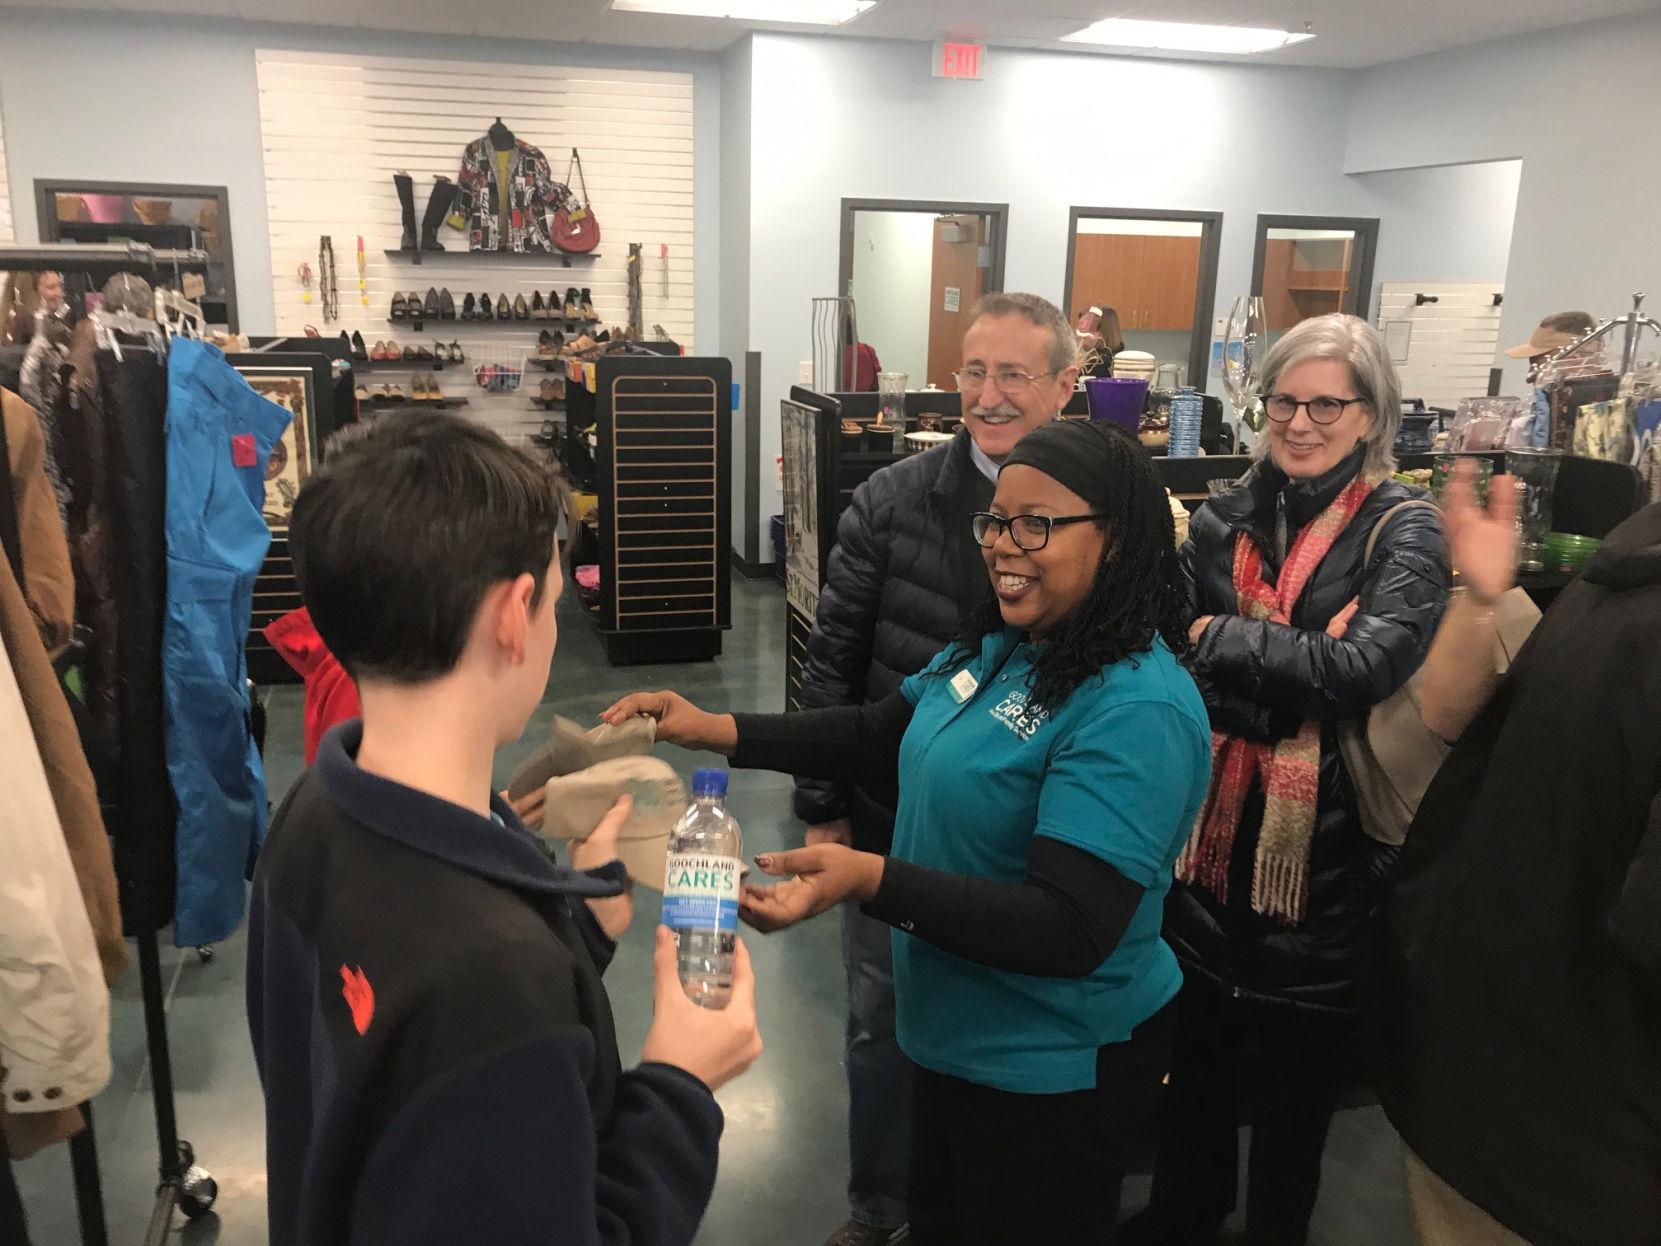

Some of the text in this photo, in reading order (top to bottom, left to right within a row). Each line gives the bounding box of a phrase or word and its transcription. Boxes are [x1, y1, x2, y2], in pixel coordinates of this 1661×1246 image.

[944, 43, 983, 78] EXIT
[996, 699, 1040, 735] CARES
[669, 859, 735, 871] GOOCHLAND
[668, 869, 734, 890] CARES
